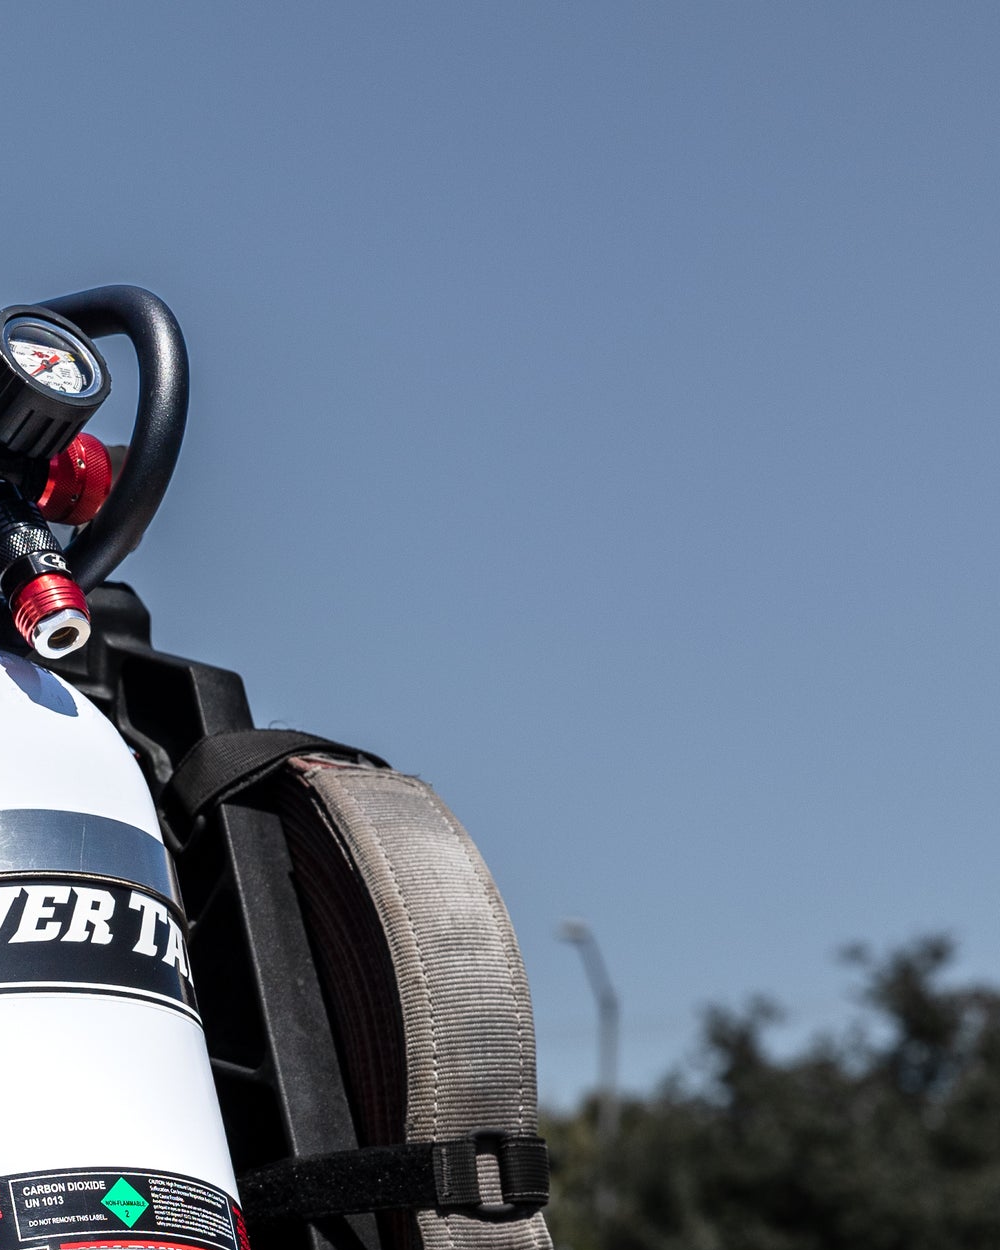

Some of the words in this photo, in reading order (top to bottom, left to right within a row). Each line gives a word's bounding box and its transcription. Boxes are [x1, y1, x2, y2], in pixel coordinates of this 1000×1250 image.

[128, 889, 194, 988] TA
[23, 1182, 65, 1196] CARBON
[67, 1180, 107, 1192] DIOXIDE
[25, 1198, 40, 1208] UN
[42, 1195, 64, 1206] 1013
[28, 1219, 39, 1227] DO
[39, 1218, 52, 1226] NOT
[51, 1216, 75, 1224] REMOVE
[75, 1214, 89, 1222] THIS
[124, 1210, 130, 1218] 2
